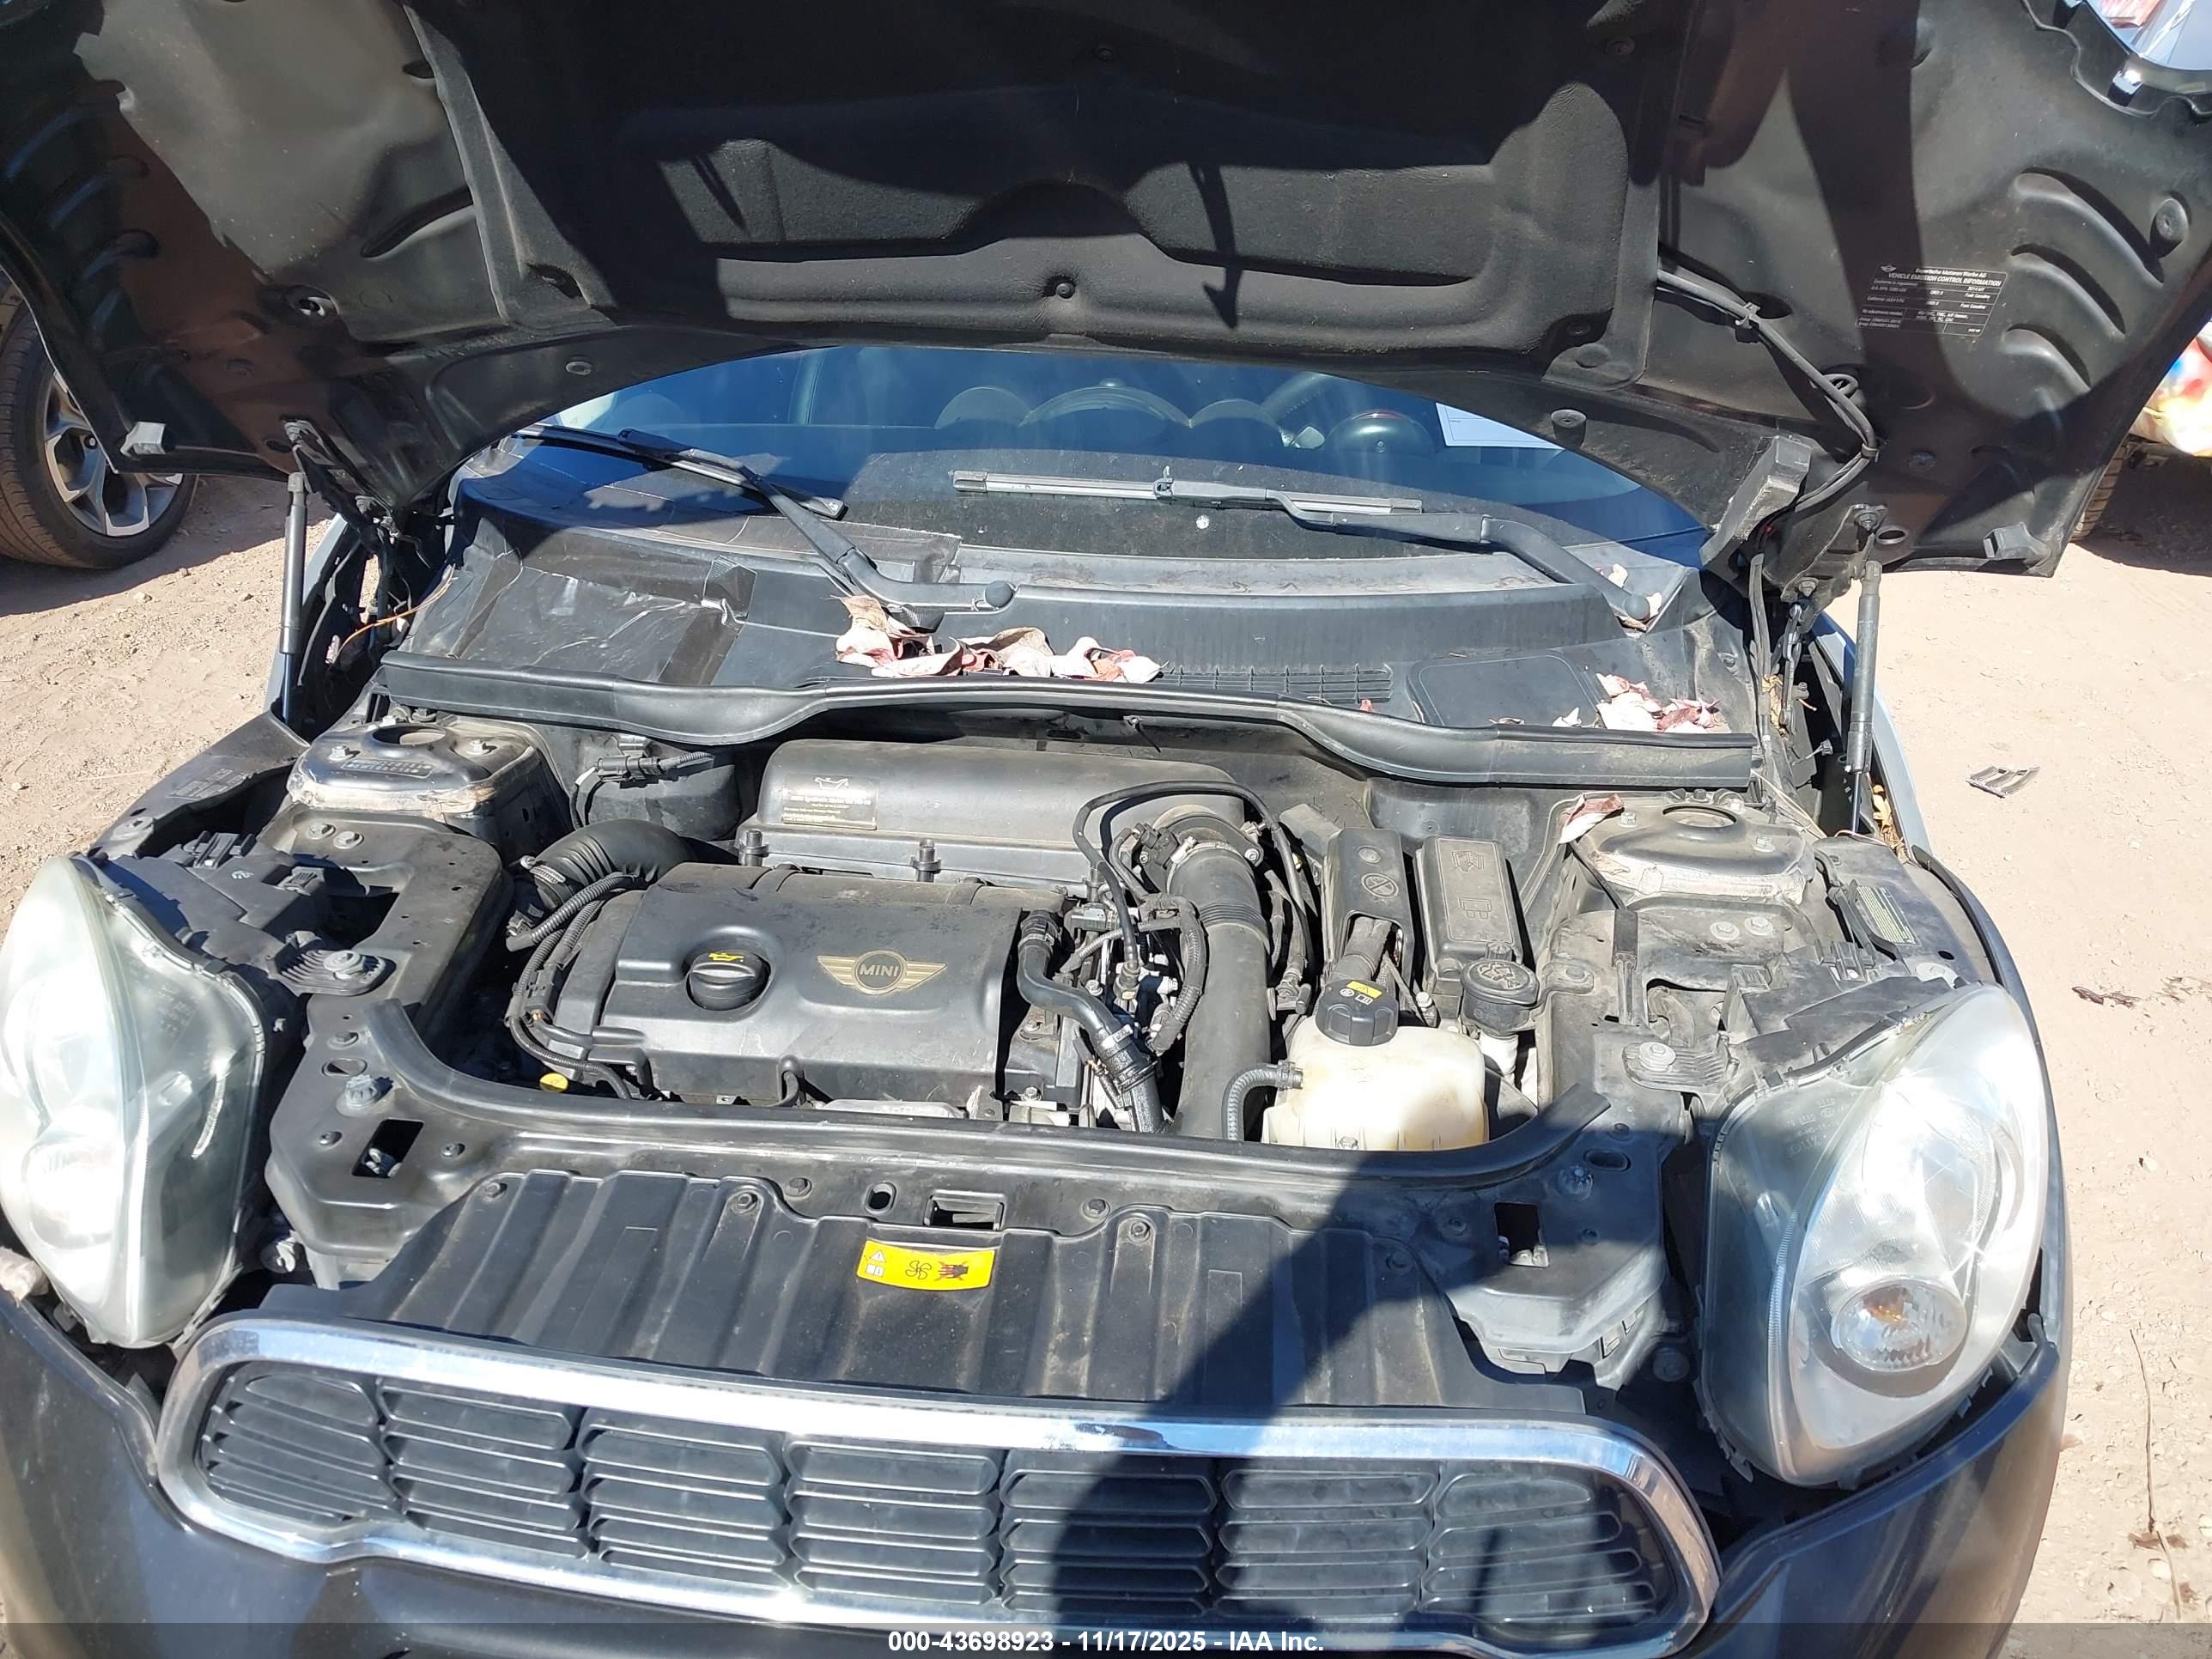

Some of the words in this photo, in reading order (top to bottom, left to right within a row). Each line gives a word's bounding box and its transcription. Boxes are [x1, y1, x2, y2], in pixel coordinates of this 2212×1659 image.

[1937, 275, 1963, 283] CONTROL
[1963, 277, 2002, 287] INFORMATION
[860, 963, 900, 977] MINI
